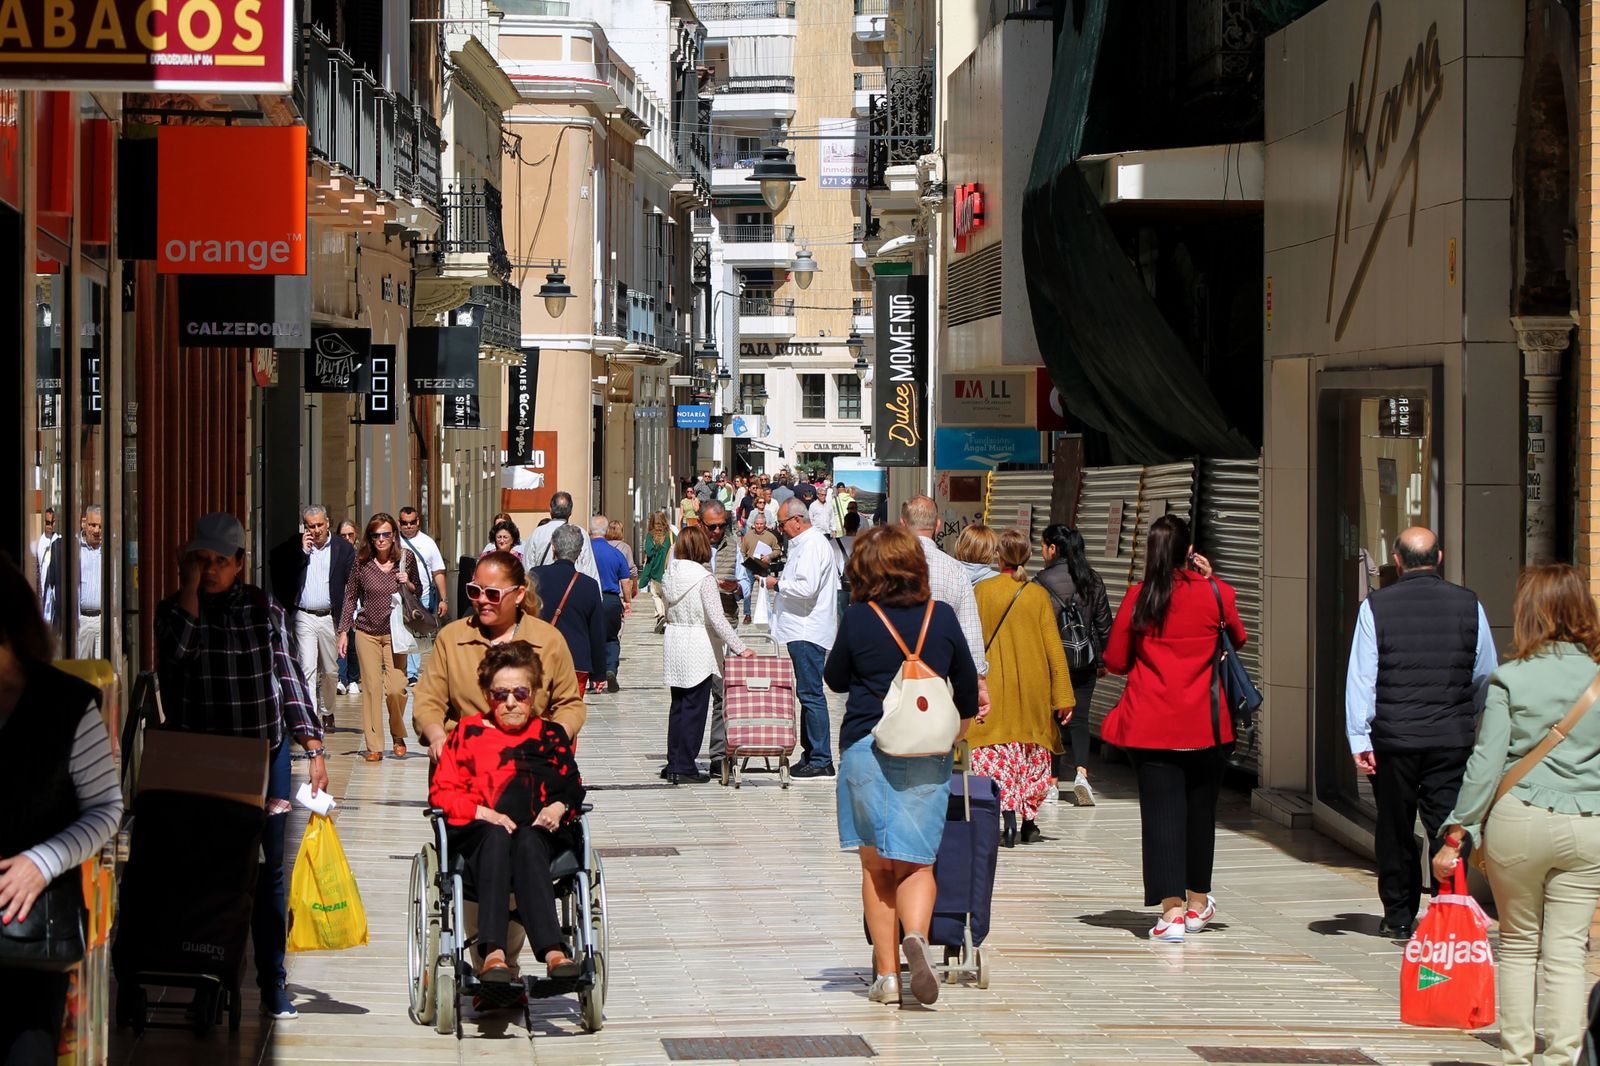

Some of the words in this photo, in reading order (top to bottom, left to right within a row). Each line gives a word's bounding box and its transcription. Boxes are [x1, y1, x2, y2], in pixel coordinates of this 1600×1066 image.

[165, 239, 290, 271] orange
[187, 322, 303, 336] CALZEDONIA
[889, 294, 915, 382] MOMENTO
[739, 343, 772, 356] CAJA
[775, 343, 822, 356] RURAL
[315, 353, 362, 377] BRUTAL
[414, 378, 475, 389] TEZENIS
[455, 396, 465, 426] LYNCIS
[885, 383, 917, 447] Dulce
[1405, 933, 1494, 970] ebajas
